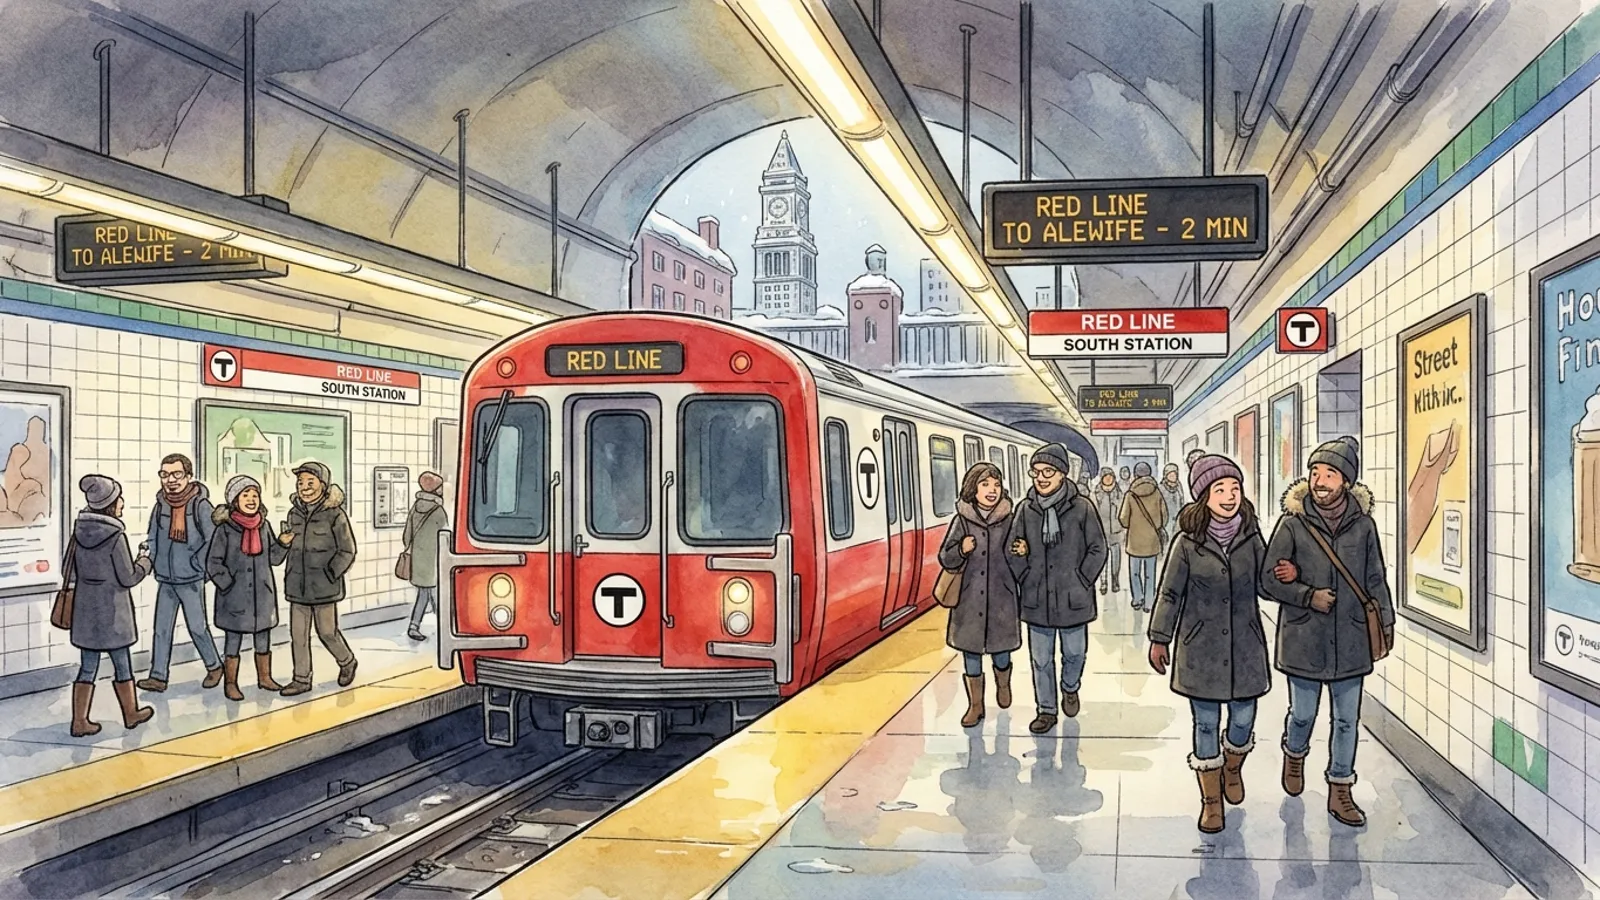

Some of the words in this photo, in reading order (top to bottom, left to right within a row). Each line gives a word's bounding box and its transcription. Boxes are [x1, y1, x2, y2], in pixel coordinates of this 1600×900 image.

[1036, 196, 1081, 218] RED
[1093, 193, 1148, 216] LINE
[95, 226, 129, 244] RED
[1002, 222, 1031, 244] TO
[1043, 219, 1145, 243] ALEWIFE
[1181, 217, 1195, 239] 2
[1206, 216, 1248, 239] MIN
[72, 248, 93, 266] TO
[200, 241, 212, 260] 2
[1081, 313, 1123, 331] RED
[1129, 313, 1176, 330] LINE
[1290, 320, 1315, 342] T
[1064, 338, 1119, 351] SOUTH
[1124, 337, 1193, 351] STATION
[214, 358, 234, 378] T
[567, 350, 607, 371] RED
[614, 349, 662, 370] LINE
[1414, 336, 1458, 379] Street
[336, 365, 362, 380] RED
[860, 463, 876, 499] T
[601, 587, 637, 618] T
[1558, 631, 1572, 650] T
